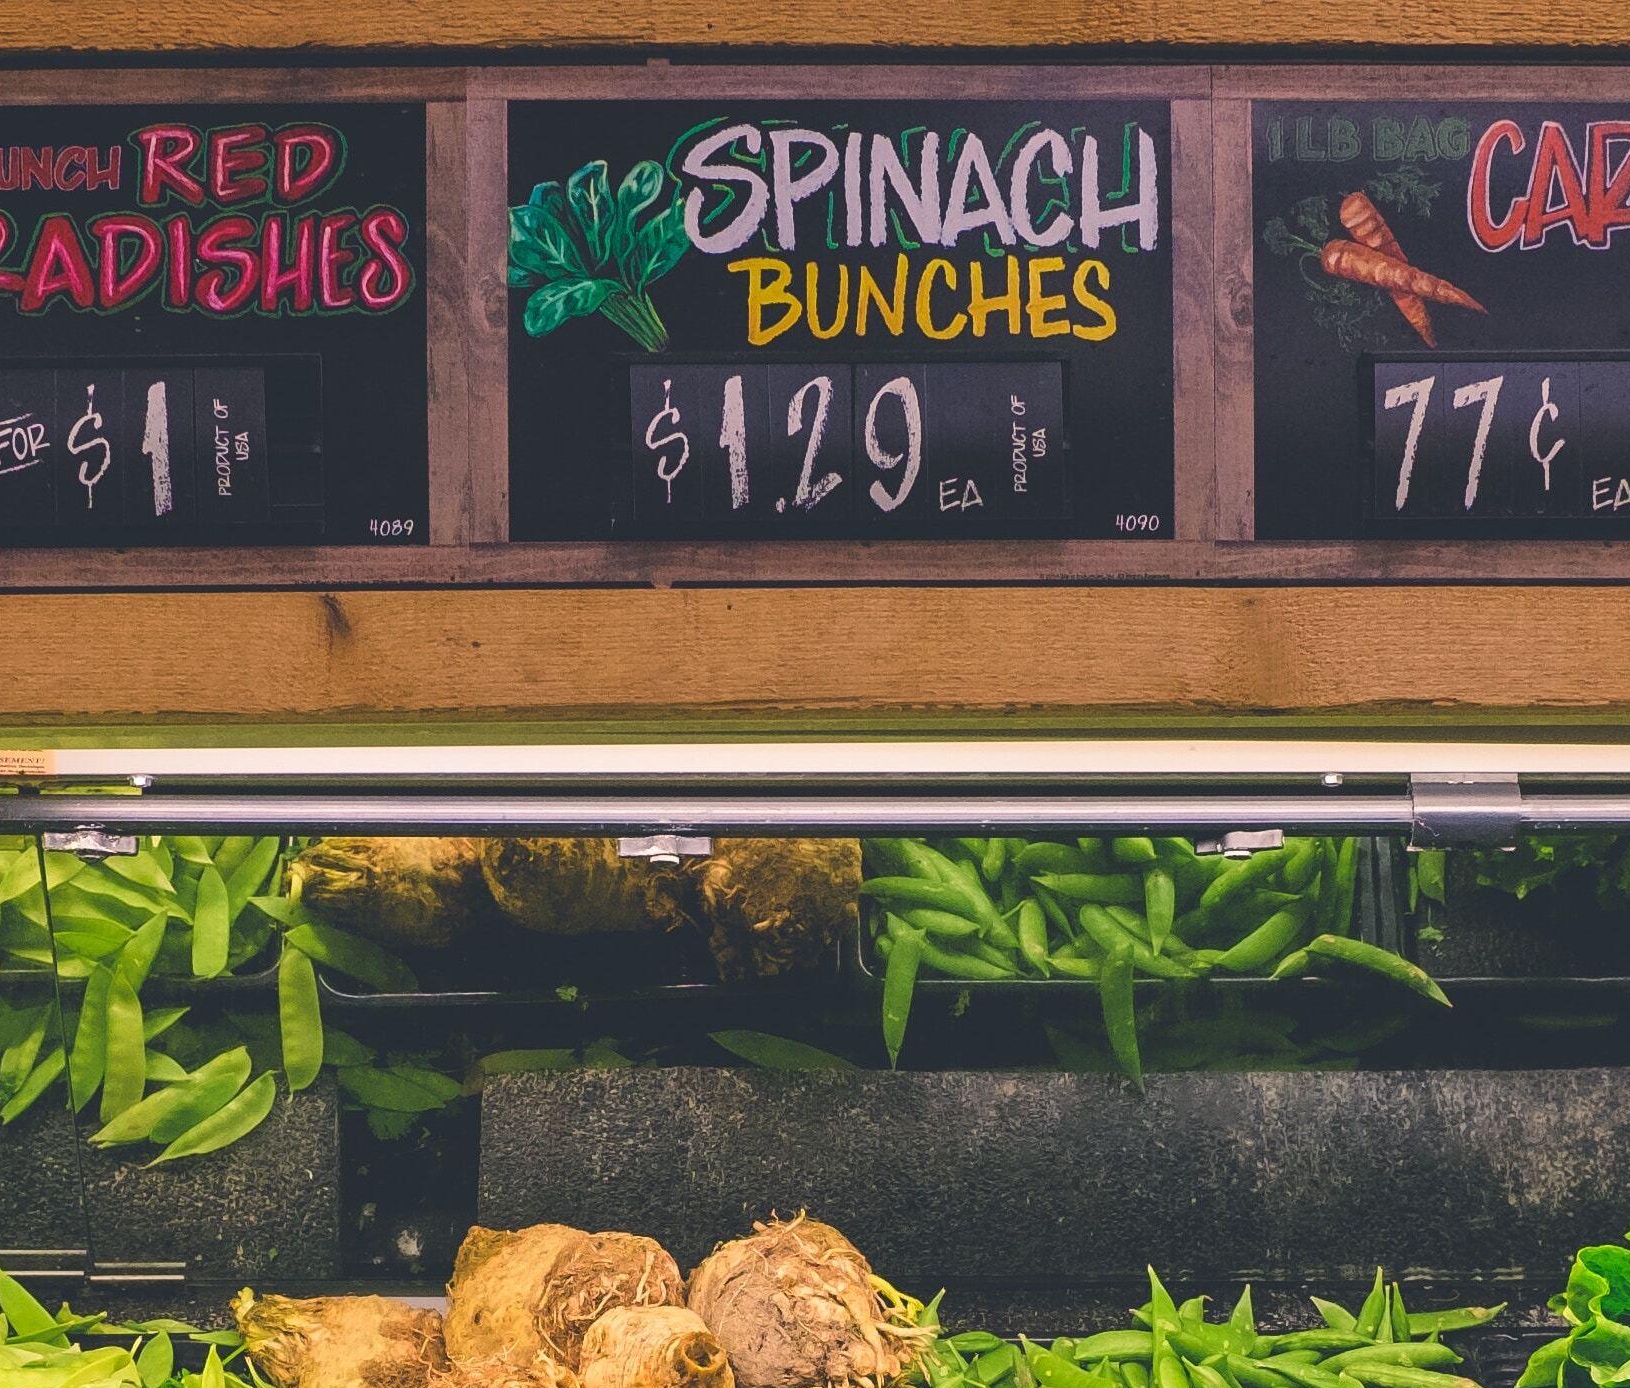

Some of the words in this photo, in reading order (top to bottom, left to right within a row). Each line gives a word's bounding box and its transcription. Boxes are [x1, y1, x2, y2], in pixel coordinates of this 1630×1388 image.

[1297, 117, 1361, 162] LB
[1371, 115, 1470, 162] BAG
[131, 121, 348, 209] RED
[682, 123, 1160, 254] SPINACH
[728, 253, 1117, 345] BUNCHES
[215, 399, 230, 420] OF
[1011, 394, 1027, 416] OF
[235, 431, 249, 461] USA
[1013, 421, 1028, 493] PRODUCT
[1032, 429, 1047, 458] USA
[217, 426, 231, 497] PRODUCT
[939, 479, 983, 513] EA
[369, 518, 415, 536] 4089
[1115, 514, 1160, 533] 4090
